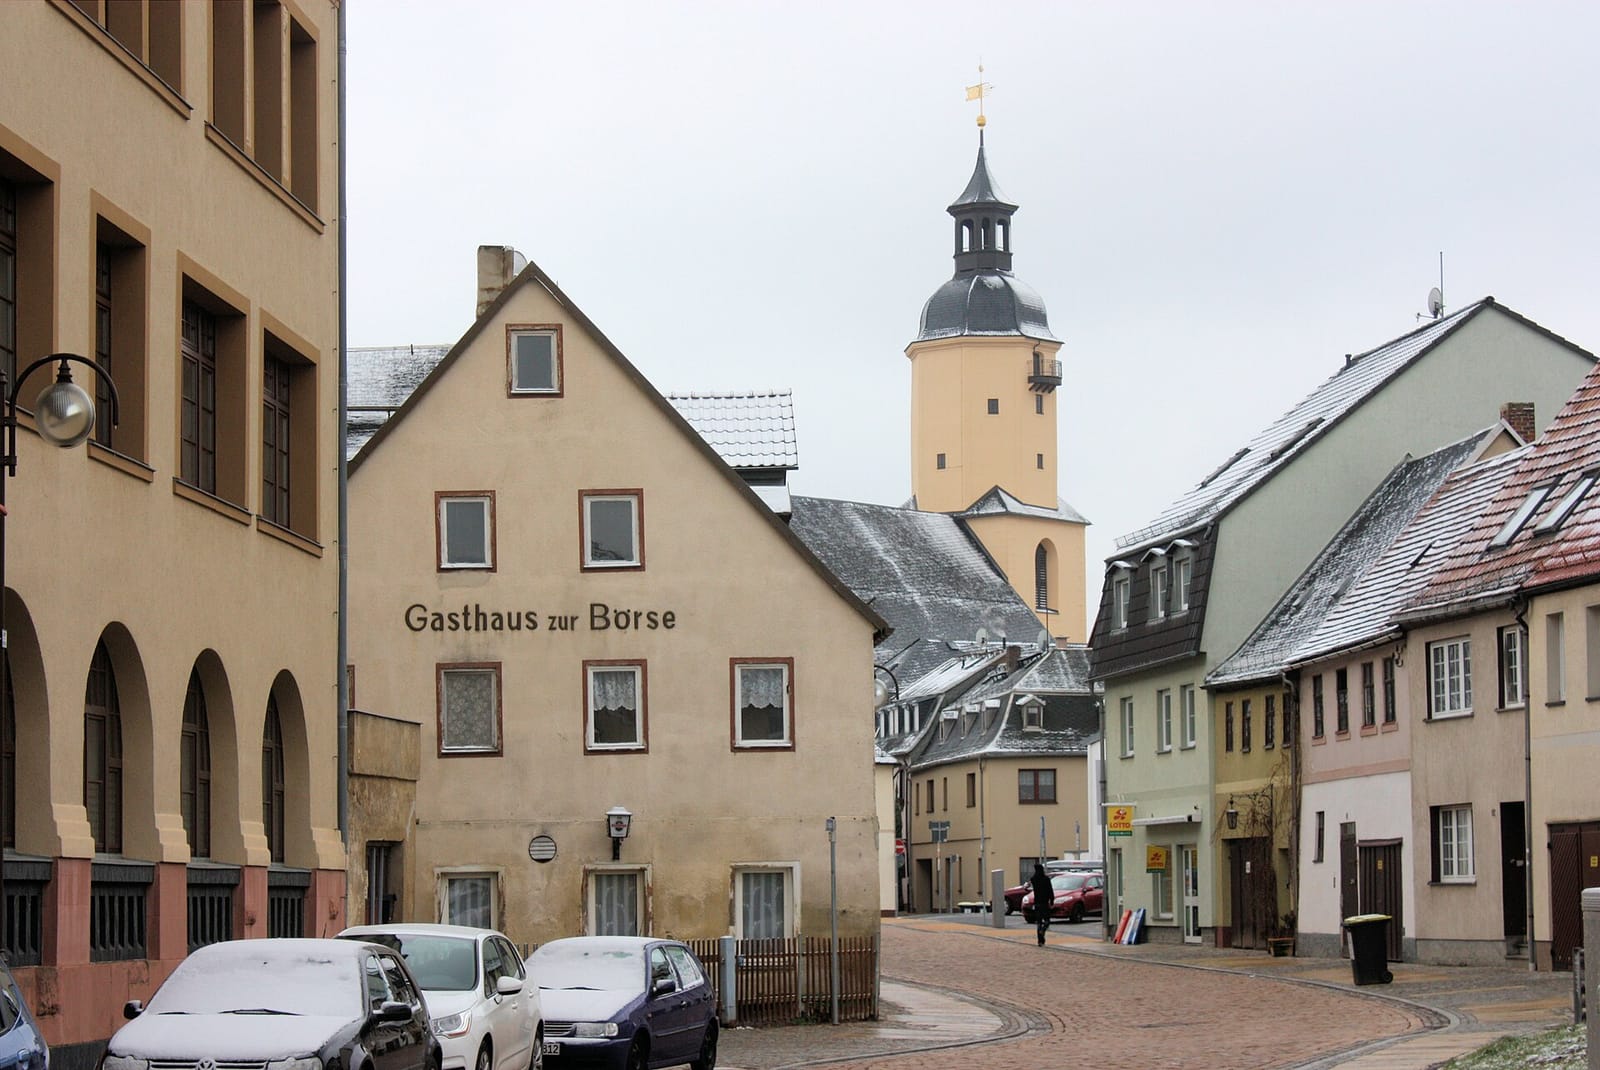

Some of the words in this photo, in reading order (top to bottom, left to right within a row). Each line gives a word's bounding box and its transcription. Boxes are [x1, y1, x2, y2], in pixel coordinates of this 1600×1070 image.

[404, 603, 538, 632] Gasthaus
[547, 615, 579, 631] zur
[589, 602, 676, 631] Börse
